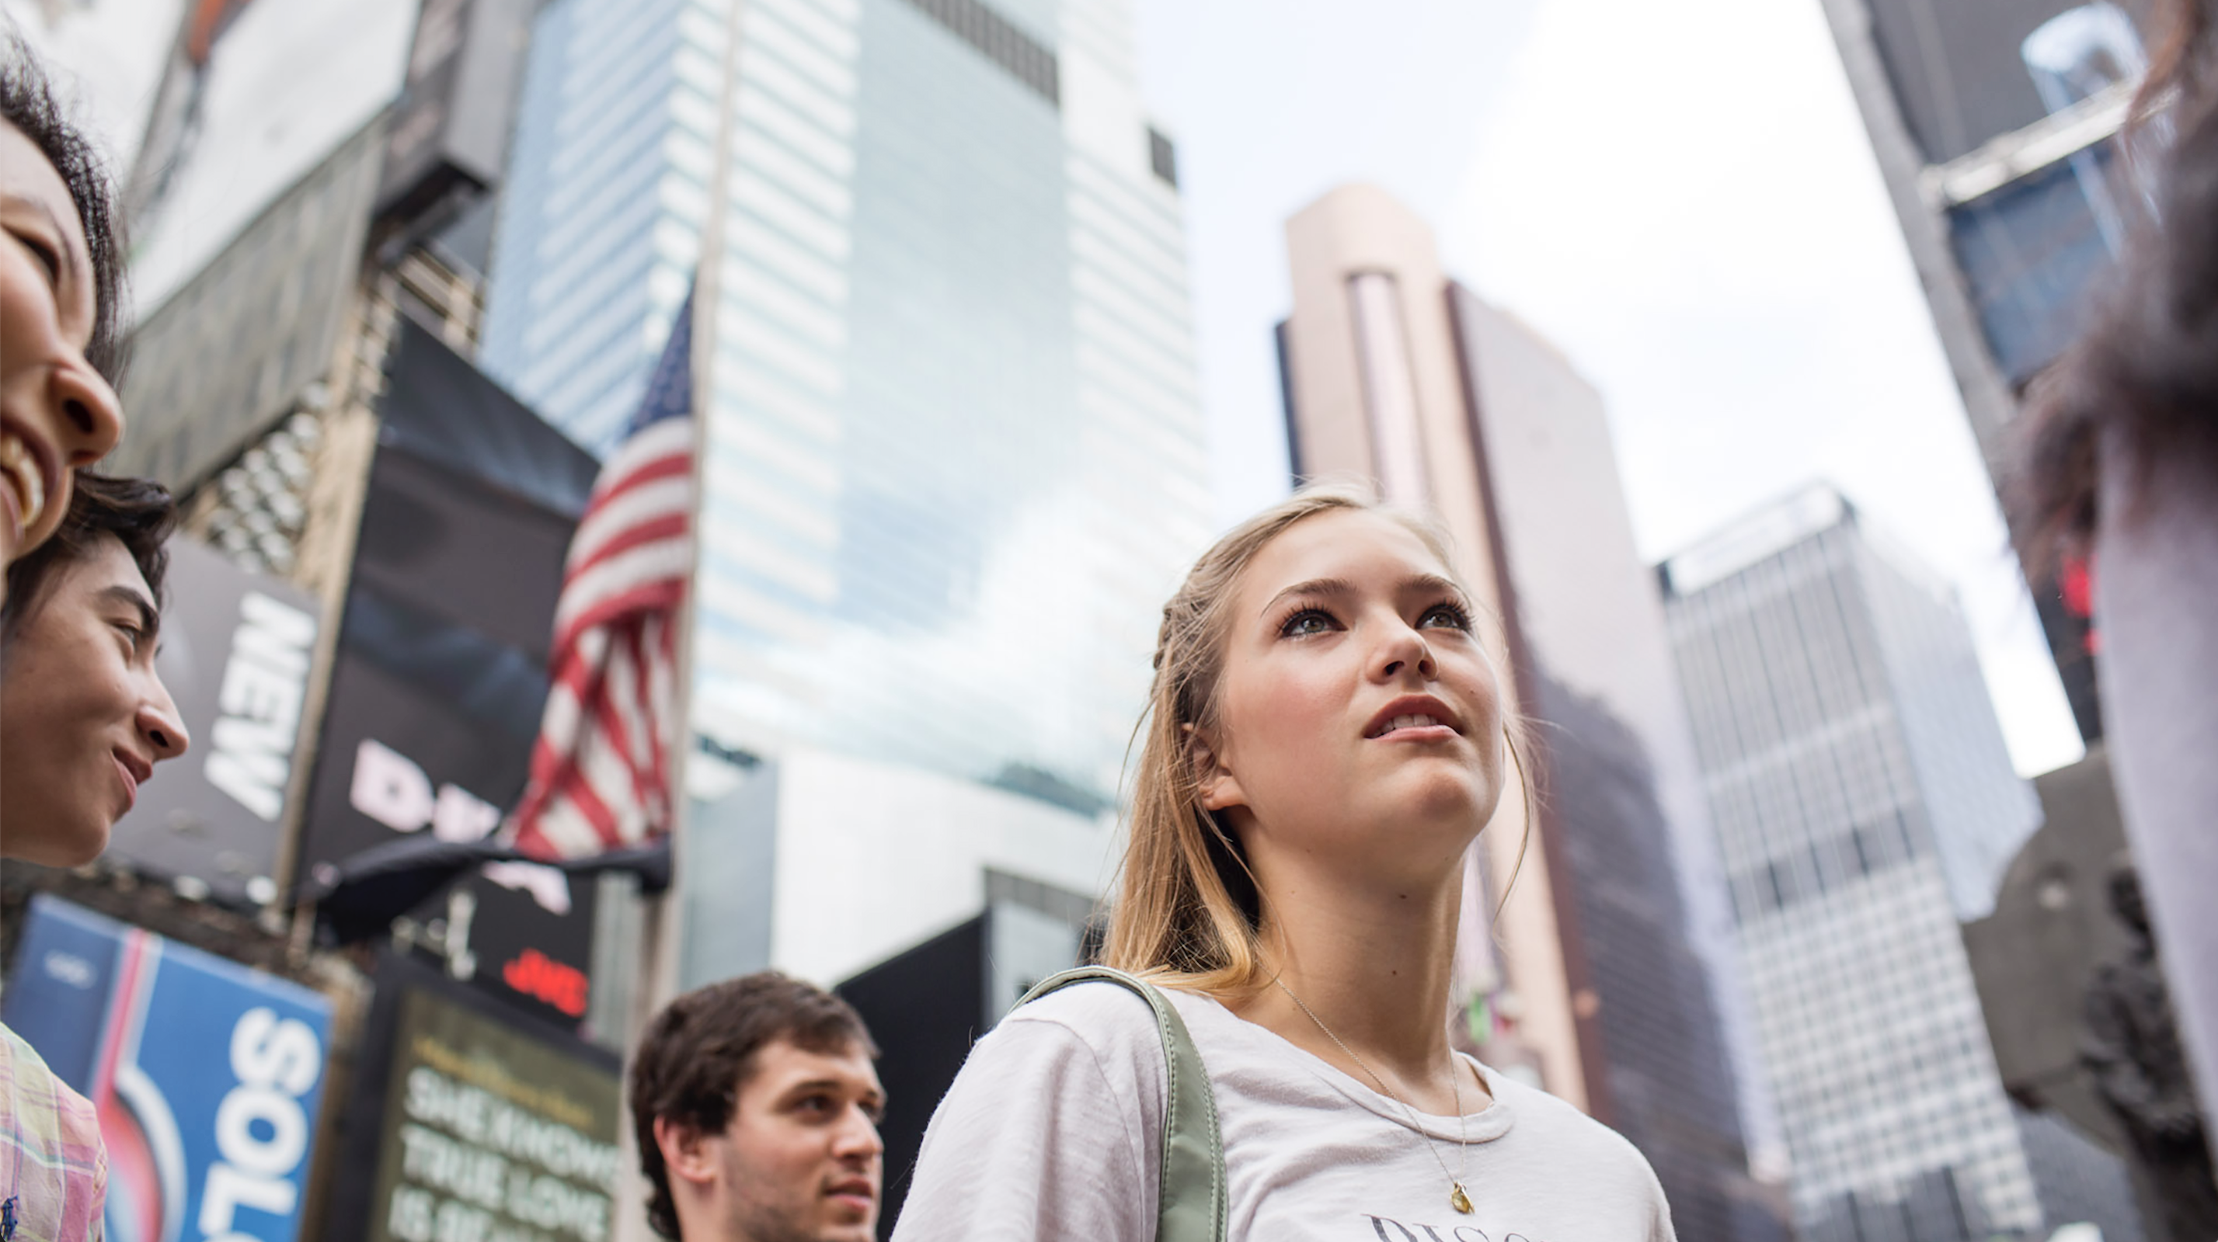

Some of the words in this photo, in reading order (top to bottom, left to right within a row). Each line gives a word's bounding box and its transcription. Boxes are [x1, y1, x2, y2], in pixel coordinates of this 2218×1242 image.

[203, 591, 317, 821] NEW
[198, 1006, 322, 1242] SOL
[401, 1122, 506, 1210] TRUE
[507, 1165, 608, 1242] LOVE
[404, 1066, 490, 1145] SHE
